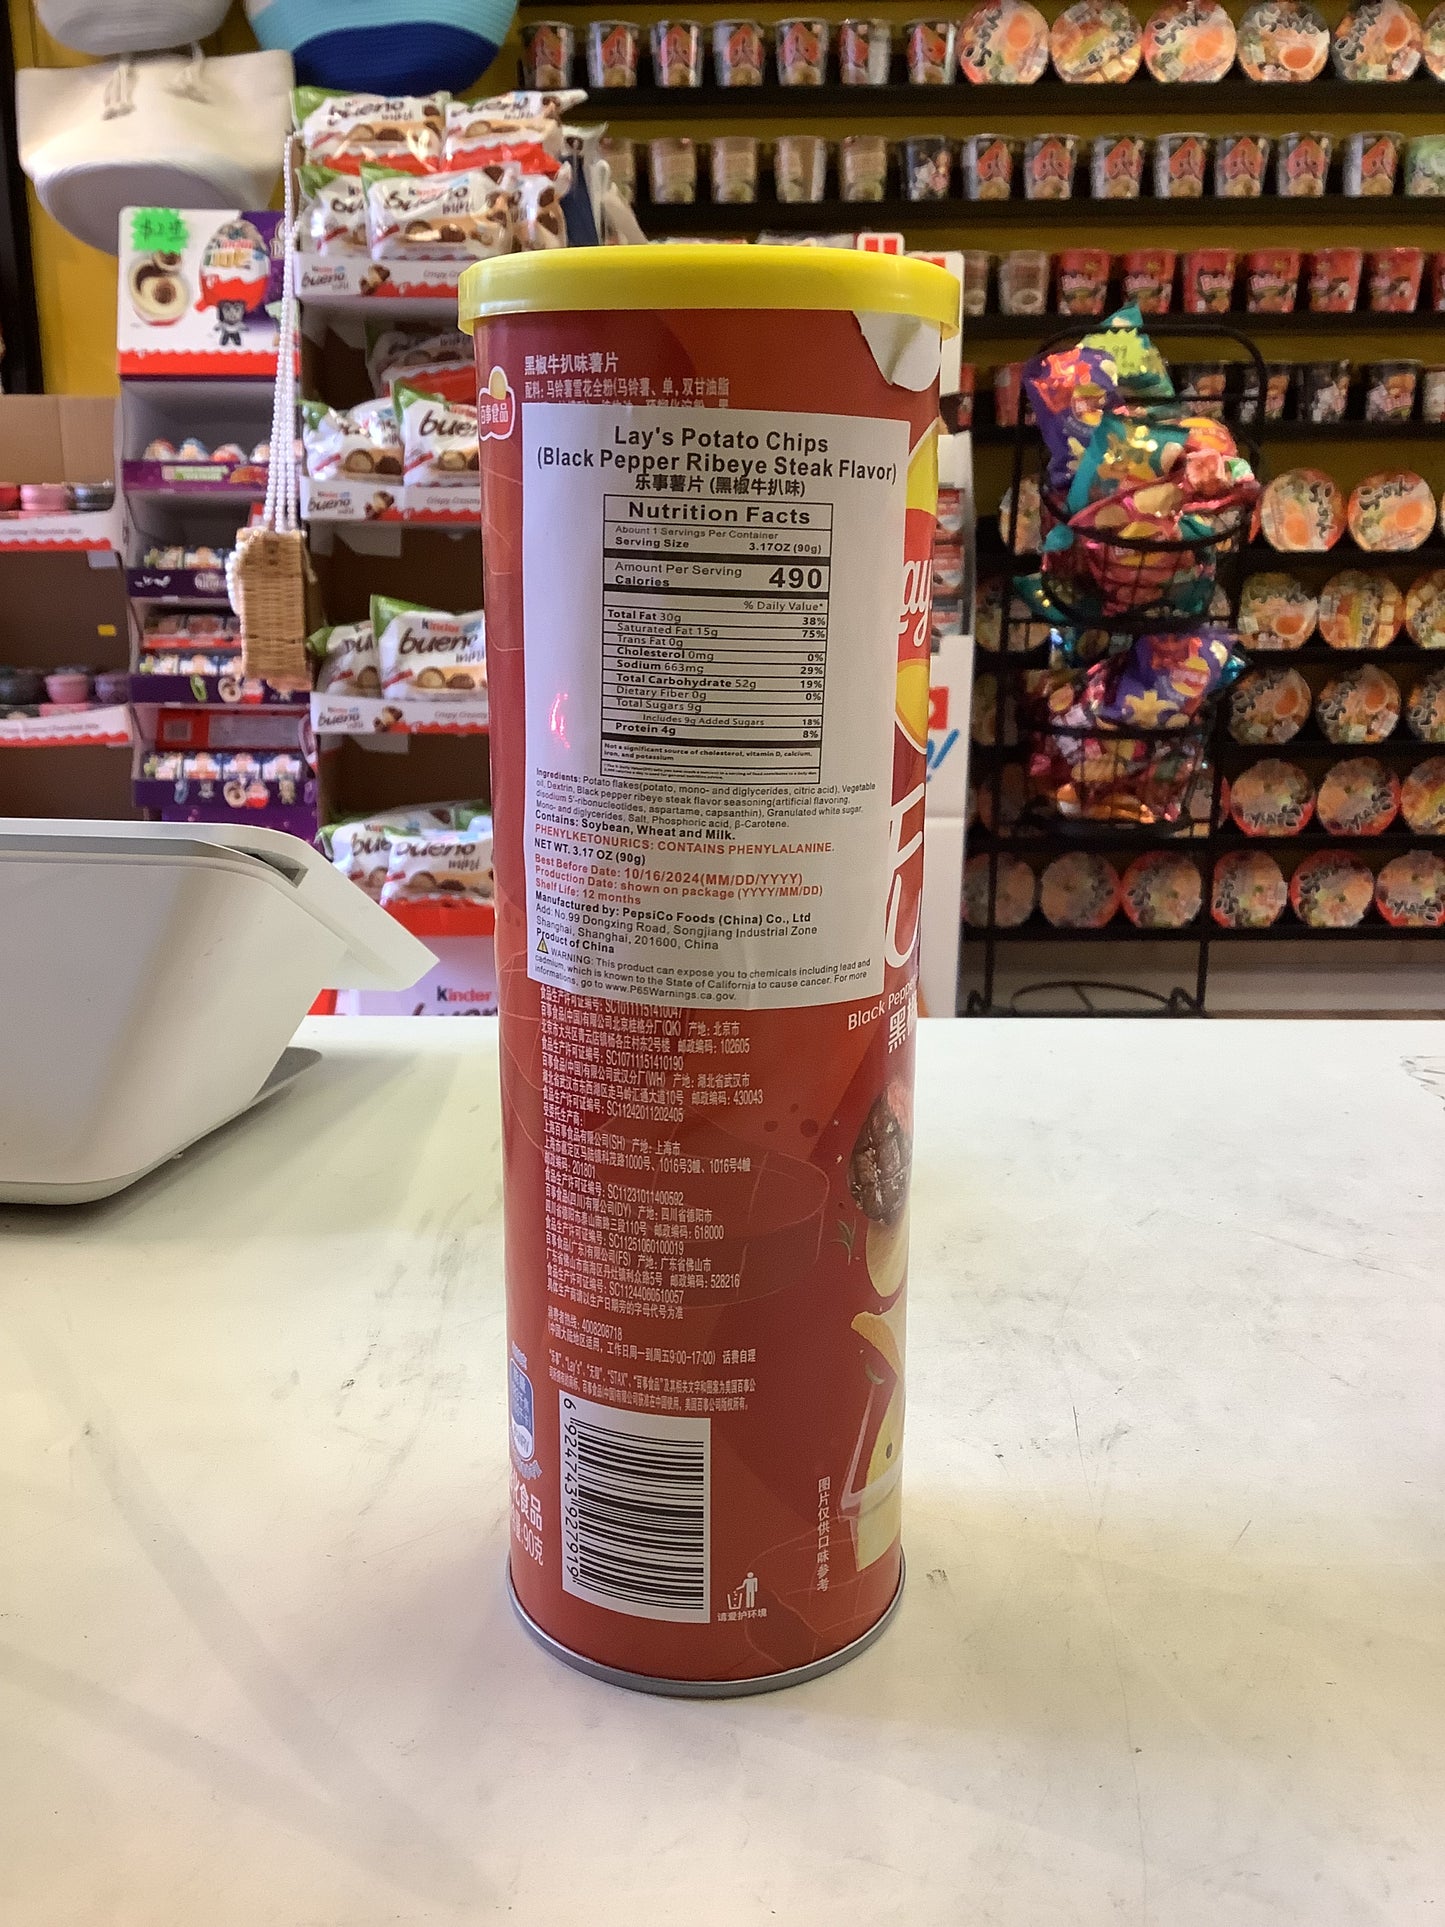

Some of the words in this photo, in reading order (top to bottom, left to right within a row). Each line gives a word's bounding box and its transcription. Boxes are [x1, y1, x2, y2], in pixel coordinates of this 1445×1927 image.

[615, 426, 673, 449] Lay's
[682, 428, 758, 450] Potato
[766, 431, 829, 456] Chips
[537, 446, 594, 470] (Black
[600, 450, 680, 473] Pepper
[686, 452, 767, 478] Ribeye
[774, 456, 834, 478] Steak
[839, 459, 897, 485] Flavor)
[629, 501, 738, 522] Nutrition
[746, 506, 811, 525] Facts
[615, 525, 650, 535] Abount
[660, 527, 706, 538] Servings
[708, 530, 727, 538] Per
[728, 531, 779, 540] Container
[615, 536, 661, 549] Serving
[663, 539, 690, 548] Size
[749, 542, 791, 552] 3.17OZ
[793, 543, 822, 555] (90g)
[615, 562, 663, 573] Amount
[666, 564, 688, 574] Per
[692, 565, 743, 578] Serving
[615, 575, 670, 587] Calories
[768, 567, 822, 589] 490
[607, 609, 636, 620] Total
[639, 611, 657, 621] Fat
[659, 612, 681, 624] 30g
[802, 617, 826, 626] 38%
[743, 601, 754, 610] %
[757, 601, 786, 613] Daily
[617, 622, 672, 635] Saturated
[675, 626, 693, 636] Fat
[696, 628, 718, 638] 15g
[801, 629, 825, 639] 75%
[617, 634, 647, 645] Trans
[650, 636, 667, 646] Fat
[668, 638, 683, 648] 0g
[616, 647, 685, 659] Cholesterol
[688, 650, 714, 661] 0mg
[807, 653, 824, 662] 0%
[616, 659, 661, 671] Sodium
[664, 662, 704, 674] 663mg
[800, 666, 823, 675] 29%
[616, 673, 645, 683] Total
[648, 675, 732, 690] Carbohydrate
[734, 679, 757, 690] 52g
[800, 680, 823, 689] 19%
[616, 686, 657, 698] Dietary
[660, 688, 690, 698] Fiber
[692, 690, 707, 700] 0g
[805, 692, 822, 701] 0%
[616, 698, 643, 707] Total
[645, 700, 684, 712] Sugars
[687, 703, 702, 713] 9g
[615, 722, 658, 733] Protein
[660, 725, 676, 736] 4g
[802, 730, 819, 739] 8%
[642, 714, 682, 723] Includes
[684, 716, 697, 726] 9g
[698, 716, 731, 725] Added
[732, 718, 765, 727] Sugars
[802, 718, 820, 726] 18%
[535, 809, 579, 826] Contains:
[581, 818, 634, 835] Soybean,
[637, 825, 676, 837] Wheat
[679, 828, 701, 838] and
[705, 829, 736, 840] Milk.
[535, 823, 654, 850] PHENYLKETONURICS:
[657, 841, 725, 854] CONTAINS
[728, 842, 834, 854] PHENYLALANINE.
[534, 837, 552, 850] NET
[553, 841, 571, 854] WT.
[573, 846, 594, 858] 3.17
[596, 849, 613, 861] OZ
[615, 852, 646, 866] (90g)
[535, 853, 554, 867] Best
[556, 858, 588, 874] Before
[590, 864, 620, 878] Date:
[624, 867, 803, 887] 10/16/2024(MM/DD/YYYY)
[535, 866, 585, 885] Production
[588, 876, 617, 890] Date:
[620, 880, 660, 895] shown
[663, 886, 679, 895] on
[682, 885, 735, 900] package
[737, 885, 823, 900] (YYYY/MM/DD)
[535, 877, 557, 893] Shelf
[558, 882, 580, 897] Life:
[582, 889, 595, 899] 12
[597, 891, 641, 905] months
[535, 890, 599, 913] Manufactured
[602, 904, 620, 917] by:
[622, 907, 673, 922] PepsiCo
[676, 911, 715, 924] Foods
[718, 914, 762, 926] (China)
[766, 914, 790, 925] Co.,
[792, 913, 811, 923] Ltd
[536, 903, 552, 916] Add:
[554, 909, 580, 924] No.99
[583, 914, 633, 932] Dongxing
[636, 922, 670, 935] Road,
[673, 923, 733, 939] Songjiang
[736, 926, 788, 938] Industrial
[791, 926, 818, 936] Zone
[536, 915, 575, 936] Shanghai,
[577, 927, 632, 945] Shanghai,
[634, 936, 681, 949] 201600,
[684, 938, 719, 950] China
[536, 928, 568, 947] Product
[569, 936, 580, 948] of
[582, 940, 615, 954] China
[551, 947, 593, 965] WARNING:
[595, 957, 615, 969] This
[617, 961, 654, 975] product
[656, 967, 674, 975] can
[677, 968, 714, 978] expose
[717, 971, 735, 979] you
[737, 970, 747, 979] to
[750, 969, 797, 978] chemicals
[799, 964, 838, 976] including
[840, 961, 856, 971] lead
[857, 958, 871, 968] and
[437, 986, 492, 1002] kinder
[848, 1000, 886, 1031] Black
[816, 1476, 831, 1592] 图片仅供口味参考
